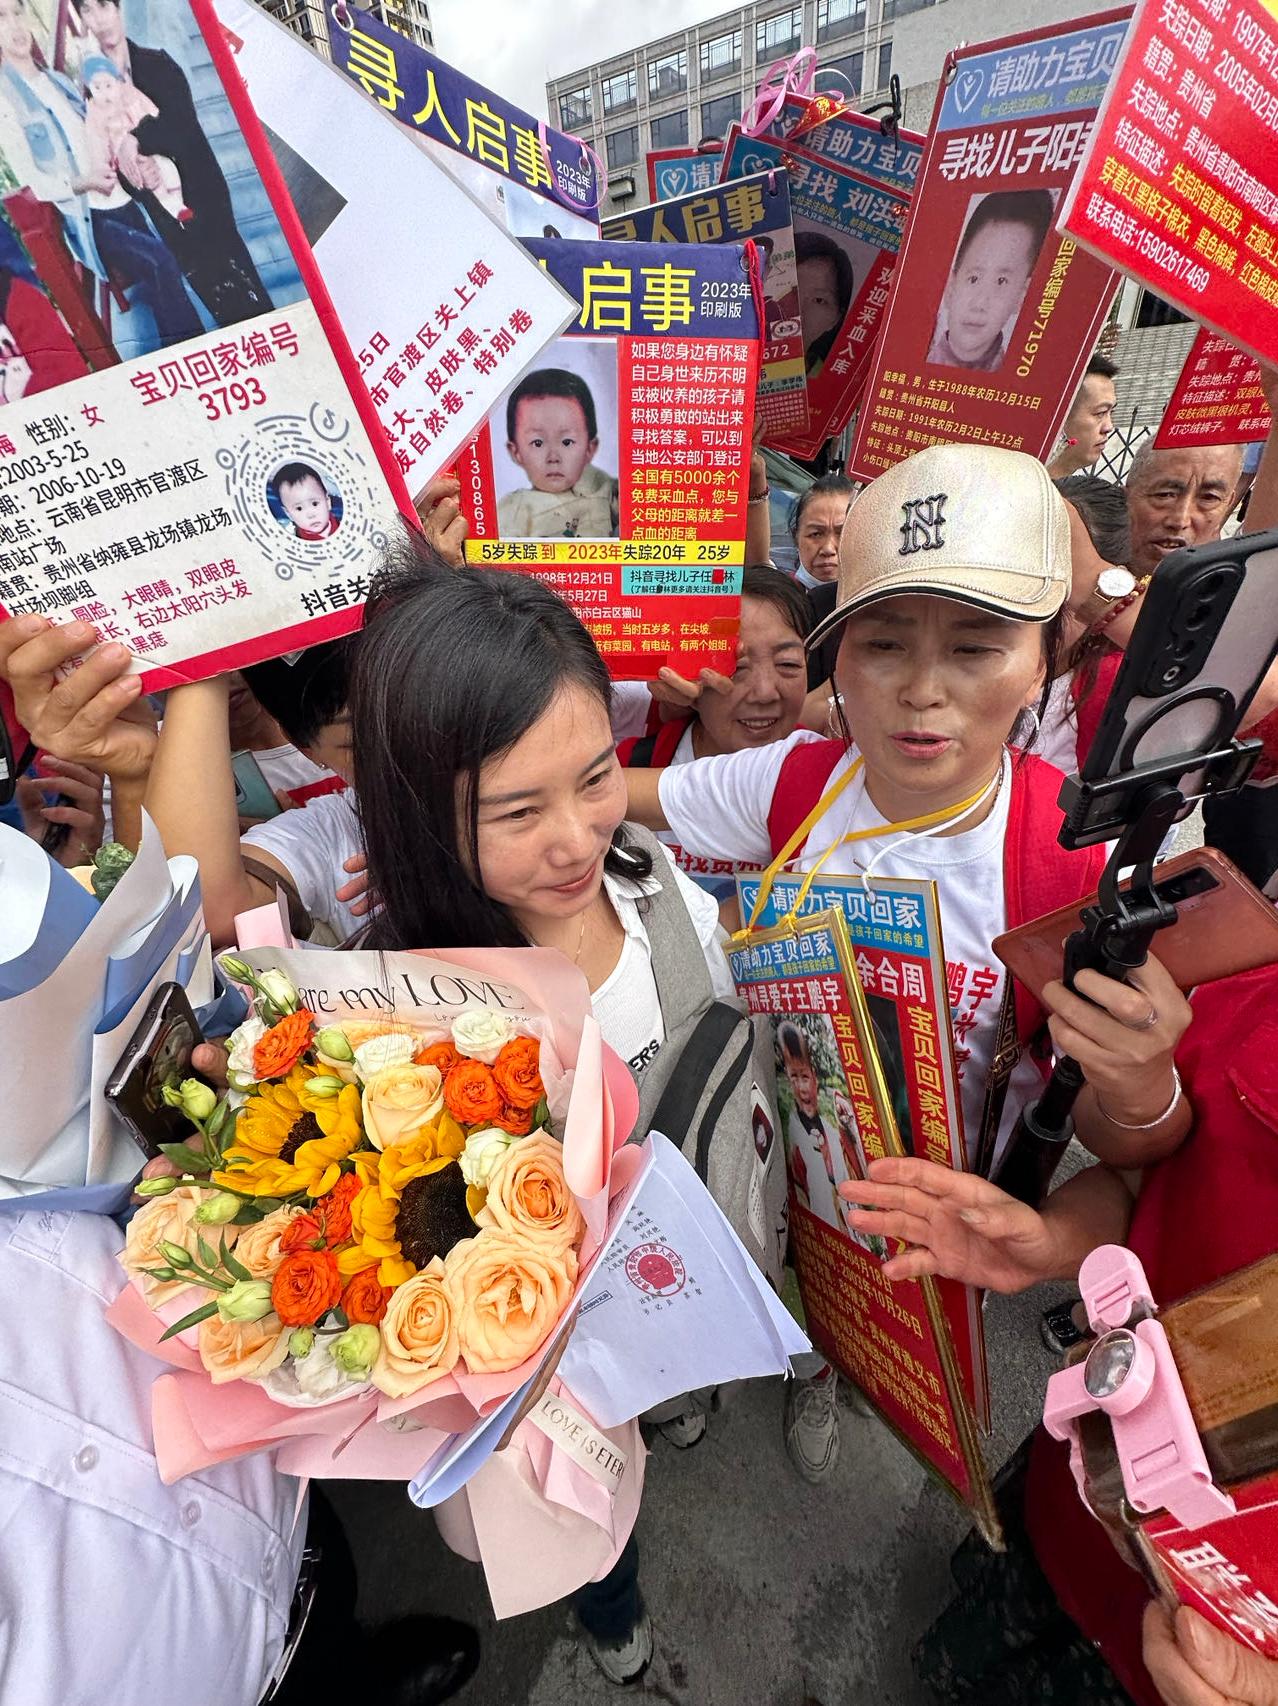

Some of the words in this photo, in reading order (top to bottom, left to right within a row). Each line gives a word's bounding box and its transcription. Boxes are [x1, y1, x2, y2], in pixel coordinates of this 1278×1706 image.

[987, 32, 1124, 98] 请助力宝贝
[1143, 35, 1217, 120] 籍贯：贵州省
[347, 29, 552, 190] 寻人启事
[804, 121, 923, 180] 请助力宝贝
[556, 159, 592, 190] 2023年
[557, 175, 588, 202] 印刷版
[788, 163, 838, 203] 寻找
[537, 259, 696, 331] 启事
[701, 282, 752, 299] 2023年
[700, 301, 743, 319] 印刷版
[830, 267, 896, 375] 欢迎采血入库
[370, 259, 494, 407] 市官渡区关上镇
[631, 341, 748, 362] 如果您身边有怀疑
[130, 322, 300, 407] 宝贝回家编号
[631, 364, 747, 384] 自己身世来历不明
[198, 377, 268, 421] 3793
[631, 386, 745, 405] 或被收养的孩子请
[25, 403, 105, 447] 性别：女
[631, 408, 744, 426] 积极勇敢的站出来
[631, 428, 743, 446] 寻找答案，可以到
[631, 449, 741, 466] 当地公安部门登记
[631, 469, 740, 486] 全国有5000余个
[631, 488, 739, 505] 免费采血点，您与
[631, 508, 738, 523] 父母的距离就差一
[631, 526, 698, 541] 点血的距离
[0, 535, 67, 573] 南站广场
[698, 545, 730, 561] 25岁
[630, 569, 735, 583] 抖音寻找儿子任林
[9, 579, 98, 617] 村场坝脚组
[771, 885, 923, 929] 请助力宝贝回家
[740, 931, 832, 970] 请助力宝贝回家
[339, 985, 396, 1015] my
[402, 973, 526, 1010] LOVE
[541, 1400, 583, 1442] LOVE
[580, 1434, 598, 1455] IS
[595, 1446, 626, 1481] ETER
